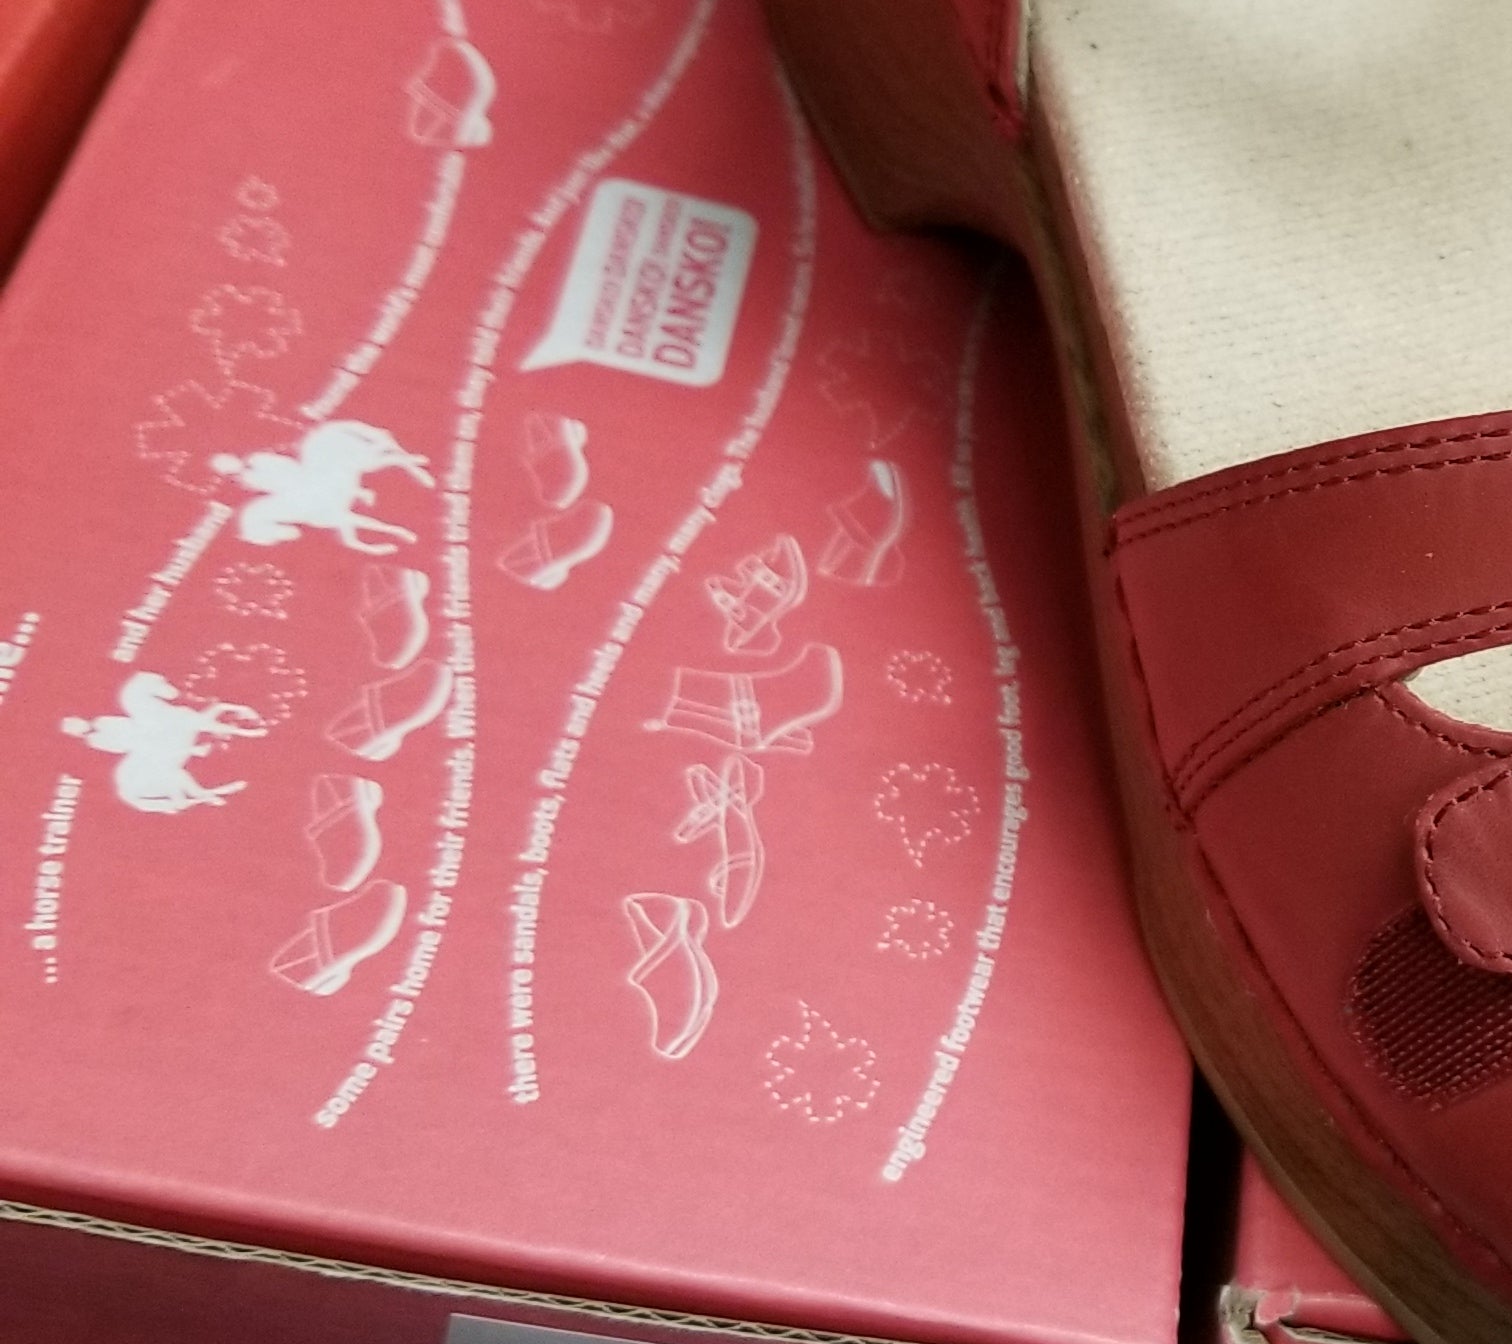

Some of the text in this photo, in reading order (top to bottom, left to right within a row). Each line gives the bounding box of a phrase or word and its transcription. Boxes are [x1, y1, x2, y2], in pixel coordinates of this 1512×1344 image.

[109, 500, 234, 663] and her husband
[441, 544, 473, 619] friends
[445, 622, 477, 674] their
[611, 601, 645, 644] and
[575, 641, 624, 695] heels
[447, 676, 476, 739] When
[566, 693, 598, 737] and
[438, 741, 475, 828] friends.
[537, 738, 581, 790] flats
[999, 727, 1030, 780] good
[37, 775, 83, 855] trainer
[518, 793, 567, 863] boots,
[992, 783, 1029, 902] encourages
[430, 830, 465, 887] their
[24, 860, 63, 931] horse
[417, 890, 453, 926] for
[509, 867, 549, 965] sandals,
[976, 905, 1008, 950] that
[390, 930, 442, 997] home
[366, 998, 415, 1065] pairs
[510, 968, 535, 1029] were
[940, 953, 996, 1052] footwear
[314, 1060, 378, 1129] some
[508, 1032, 541, 1104] there
[882, 1051, 961, 1182] engineered
